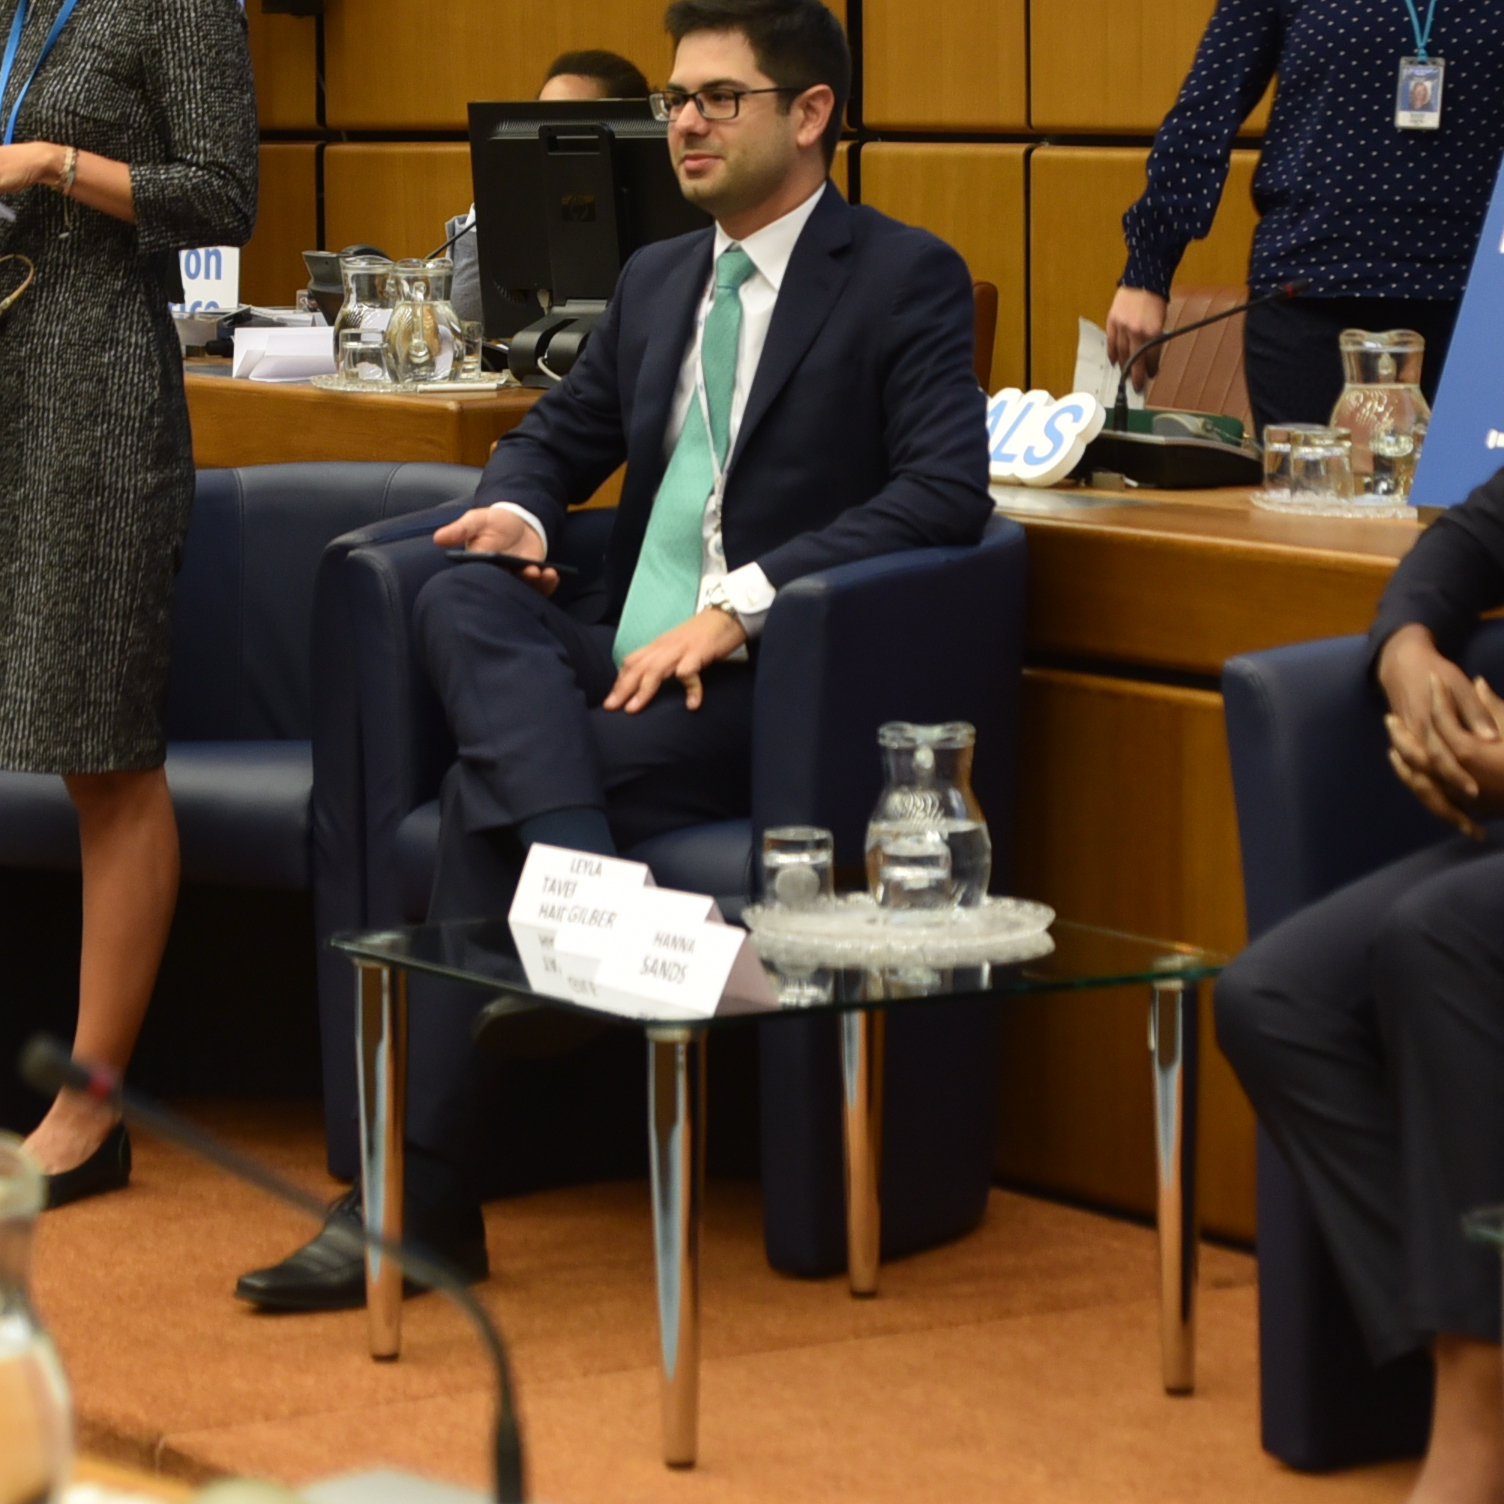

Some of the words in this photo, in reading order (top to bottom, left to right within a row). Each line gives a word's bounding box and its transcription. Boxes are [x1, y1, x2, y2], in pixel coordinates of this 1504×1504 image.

[567, 905, 618, 929] GILBER
[655, 932, 696, 954] HANNA
[640, 956, 688, 984] SANDS
